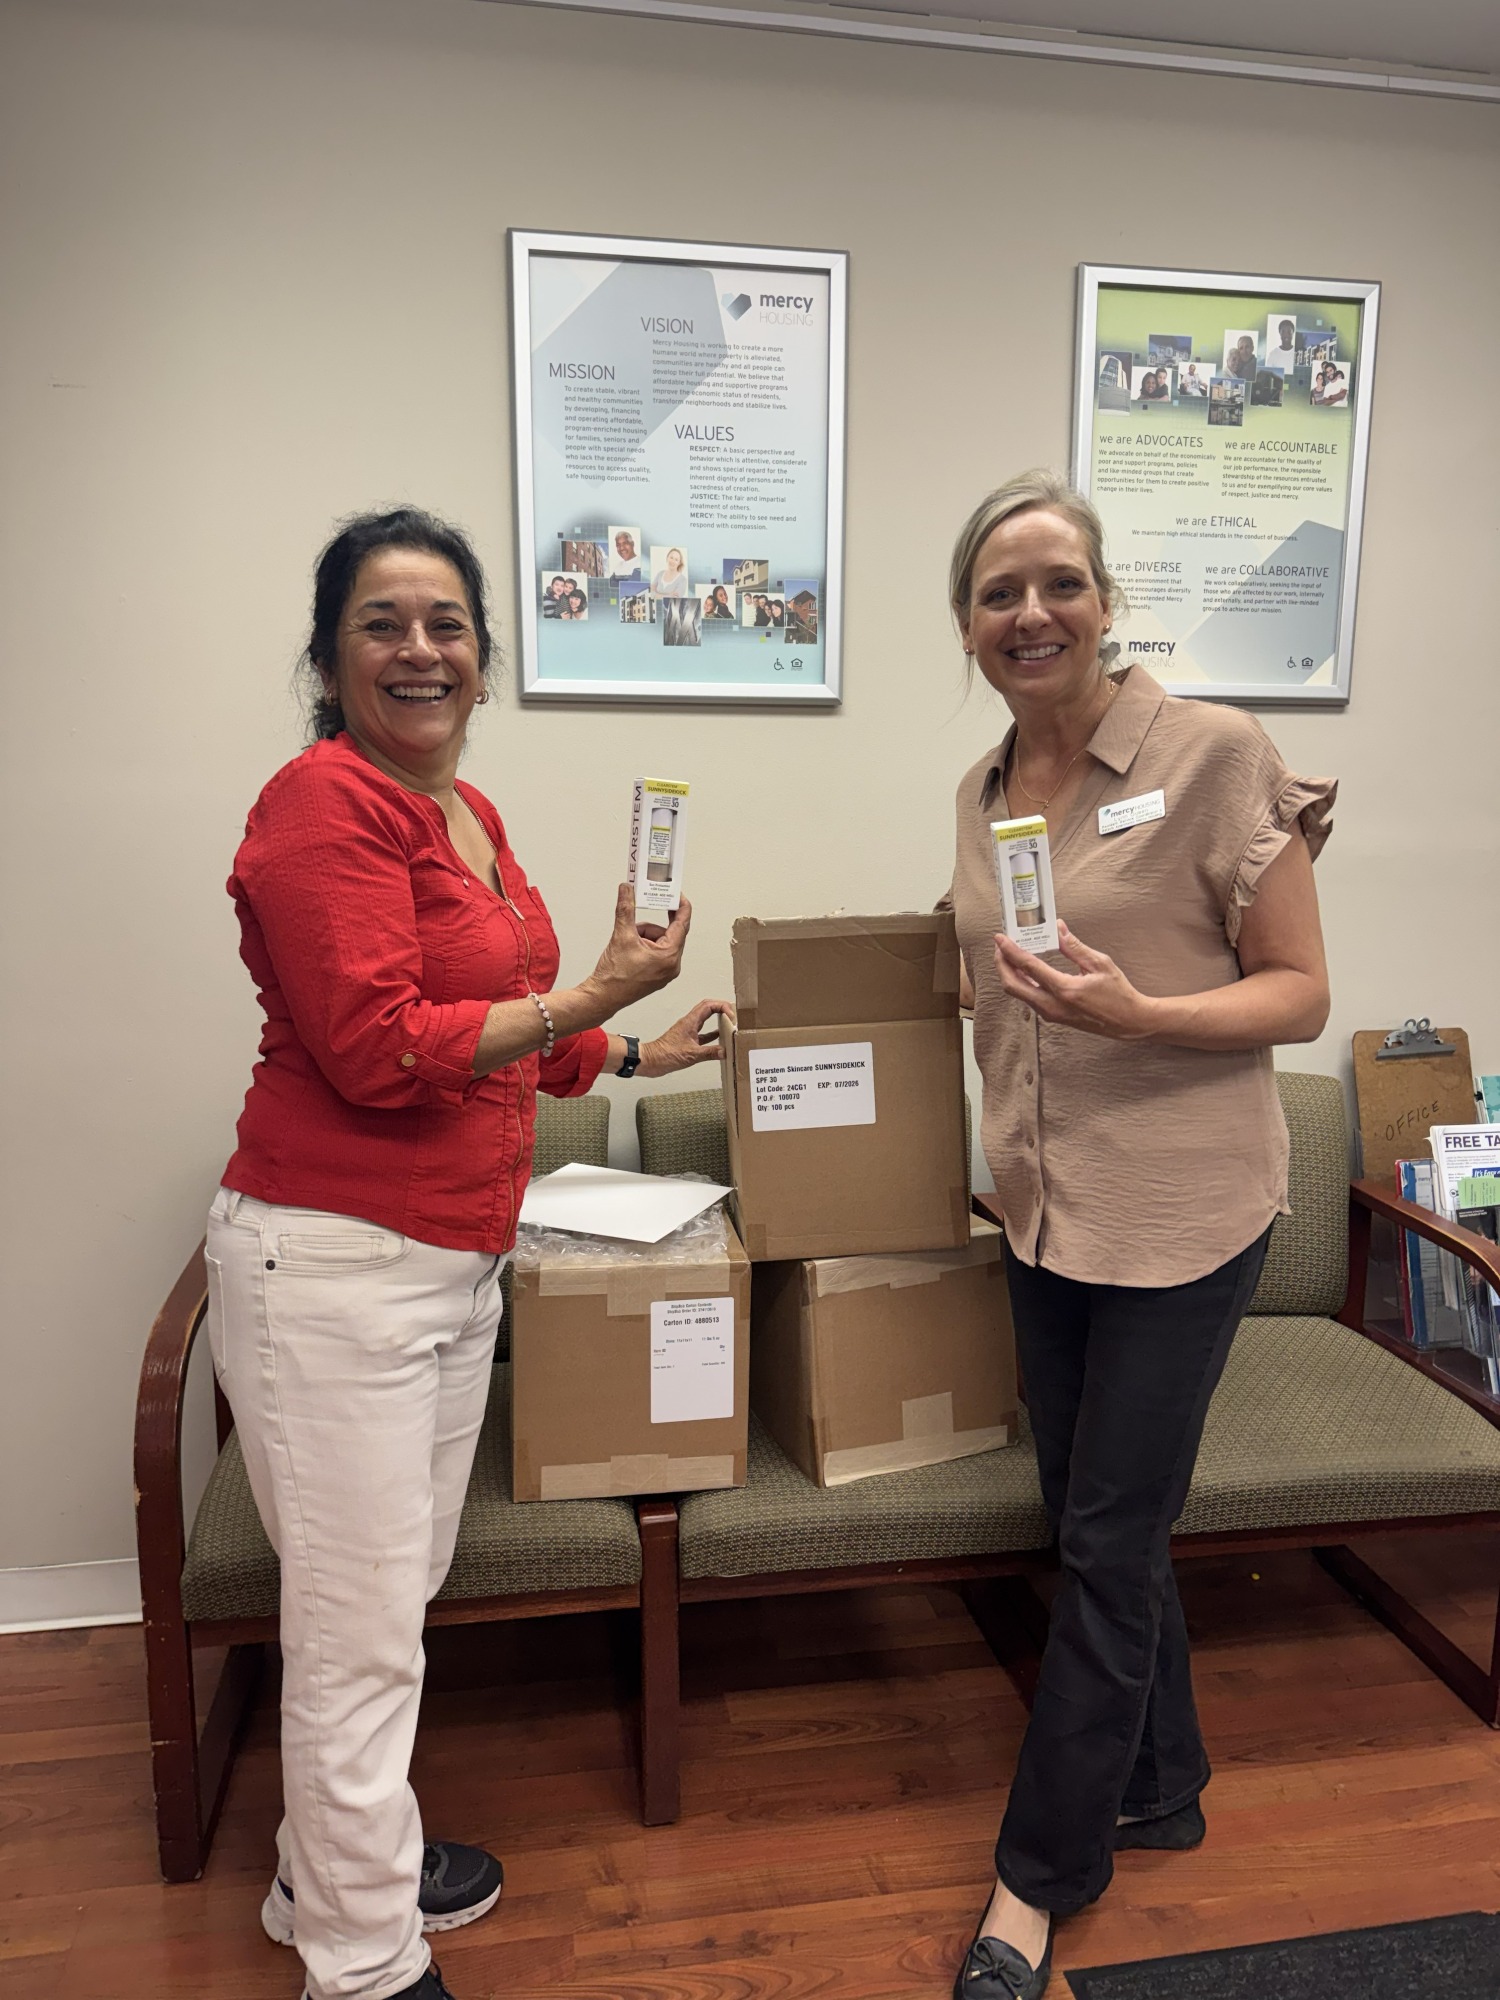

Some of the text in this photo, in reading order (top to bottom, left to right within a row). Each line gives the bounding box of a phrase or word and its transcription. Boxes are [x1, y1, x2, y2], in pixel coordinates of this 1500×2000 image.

[760, 293, 813, 312] mercy
[759, 311, 813, 326] HOUSING
[641, 317, 694, 334] VISION
[549, 363, 615, 380] MISSION
[578, 396, 601, 405] healthy
[653, 397, 683, 405] transform
[686, 399, 731, 407] neighborhoods
[746, 401, 770, 409] stabilize
[565, 405, 640, 416] by developing, financing
[578, 416, 608, 424] operating
[610, 416, 643, 425] affordable,
[623, 427, 647, 436] housing
[674, 425, 734, 442] VALUES
[576, 434, 602, 442] families,
[1100, 435, 1203, 448] we are ADVOCATES
[565, 444, 586, 452] people
[747, 448, 782, 456] perspective
[1225, 440, 1337, 454] we are ACCOUNTABLE
[629, 466, 651, 474] quality,
[723, 466, 744, 474] special
[746, 467, 765, 475] regard
[581, 473, 605, 482] housing
[607, 475, 650, 483] opportunities.
[717, 475, 737, 484] dignity
[759, 496, 786, 504] impartial
[690, 502, 720, 510] treatment
[730, 513, 747, 522] ability
[1192, 518, 1207, 526] are
[1211, 516, 1257, 528] ETHICAL
[690, 522, 714, 530] respond
[1167, 530, 1178, 538] high
[1180, 530, 1198, 538] ethical
[1200, 531, 1226, 539] standards
[1116, 563, 1131, 571] are
[1135, 561, 1182, 573] DIVERSE
[1205, 564, 1329, 578] we are COLLABORATIVE
[1129, 641, 1176, 656] mercy
[647, 786, 687, 795] SUNNYSIDEKICK
[629, 786, 642, 885] LEARSTEM
[999, 829, 1043, 841] SUNNYSIDEKICK
[815, 1061, 865, 1070] SUNNYSIDEKICK
[834, 1080, 859, 1088] 07/2026
[1386, 1099, 1440, 1142] OFFICE
[1445, 1136, 1481, 1148] FREE
